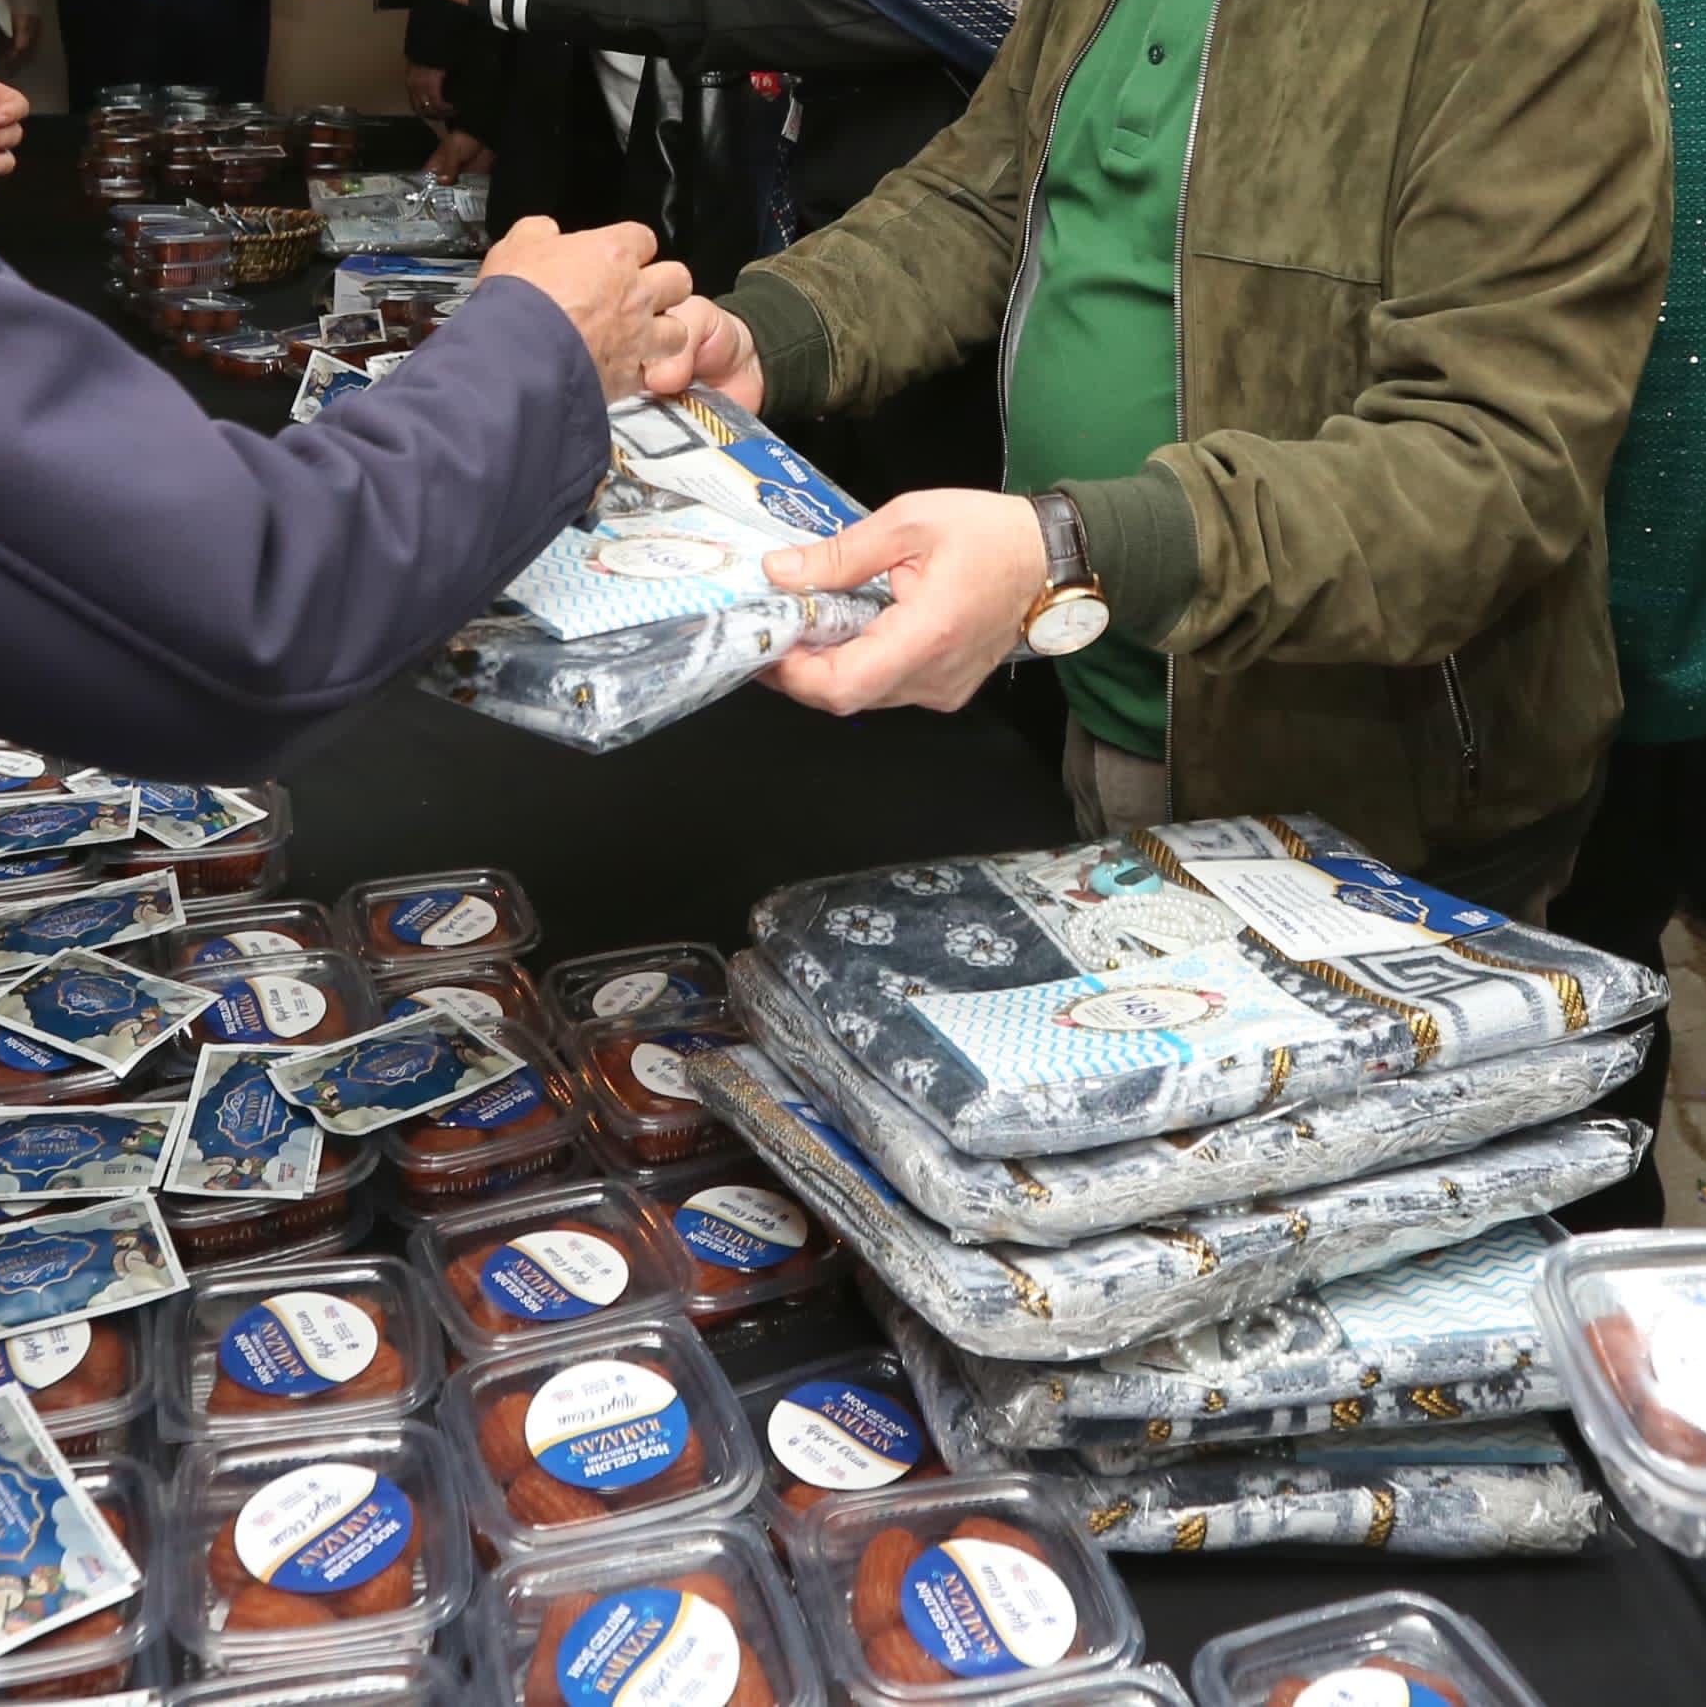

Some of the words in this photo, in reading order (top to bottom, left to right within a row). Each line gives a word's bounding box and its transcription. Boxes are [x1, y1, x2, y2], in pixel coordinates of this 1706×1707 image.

[699, 1215, 767, 1251] RAMAZAN
[491, 1270, 526, 1299] GELDİN
[515, 1258, 569, 1304] RAMAZAN
[520, 1294, 544, 1314] HOŞ
[233, 1332, 262, 1367] GELDİN
[261, 1321, 306, 1377] RAMAZAN
[253, 1362, 275, 1386] HOŞ
[820, 1401, 893, 1452] RAMAZAN
[841, 1391, 869, 1411] HOŞ
[866, 1407, 910, 1439] GELDİN
[569, 1418, 662, 1456] RAMAZAN
[638, 1441, 671, 1460] HOŞ
[583, 1452, 638, 1478] GELDİN
[296, 1500, 381, 1566] RAMAZAN
[370, 1518, 402, 1545] HOŞ
[323, 1542, 374, 1582] GELDİN
[914, 1580, 950, 1631] GELDİN
[943, 1572, 1000, 1655] RAMAZAN
[566, 1645, 597, 1679] HOŞ
[588, 1602, 632, 1651] GELDİN
[596, 1620, 664, 1694] RAMAZAN
[941, 1629, 967, 1662] HOŞ
